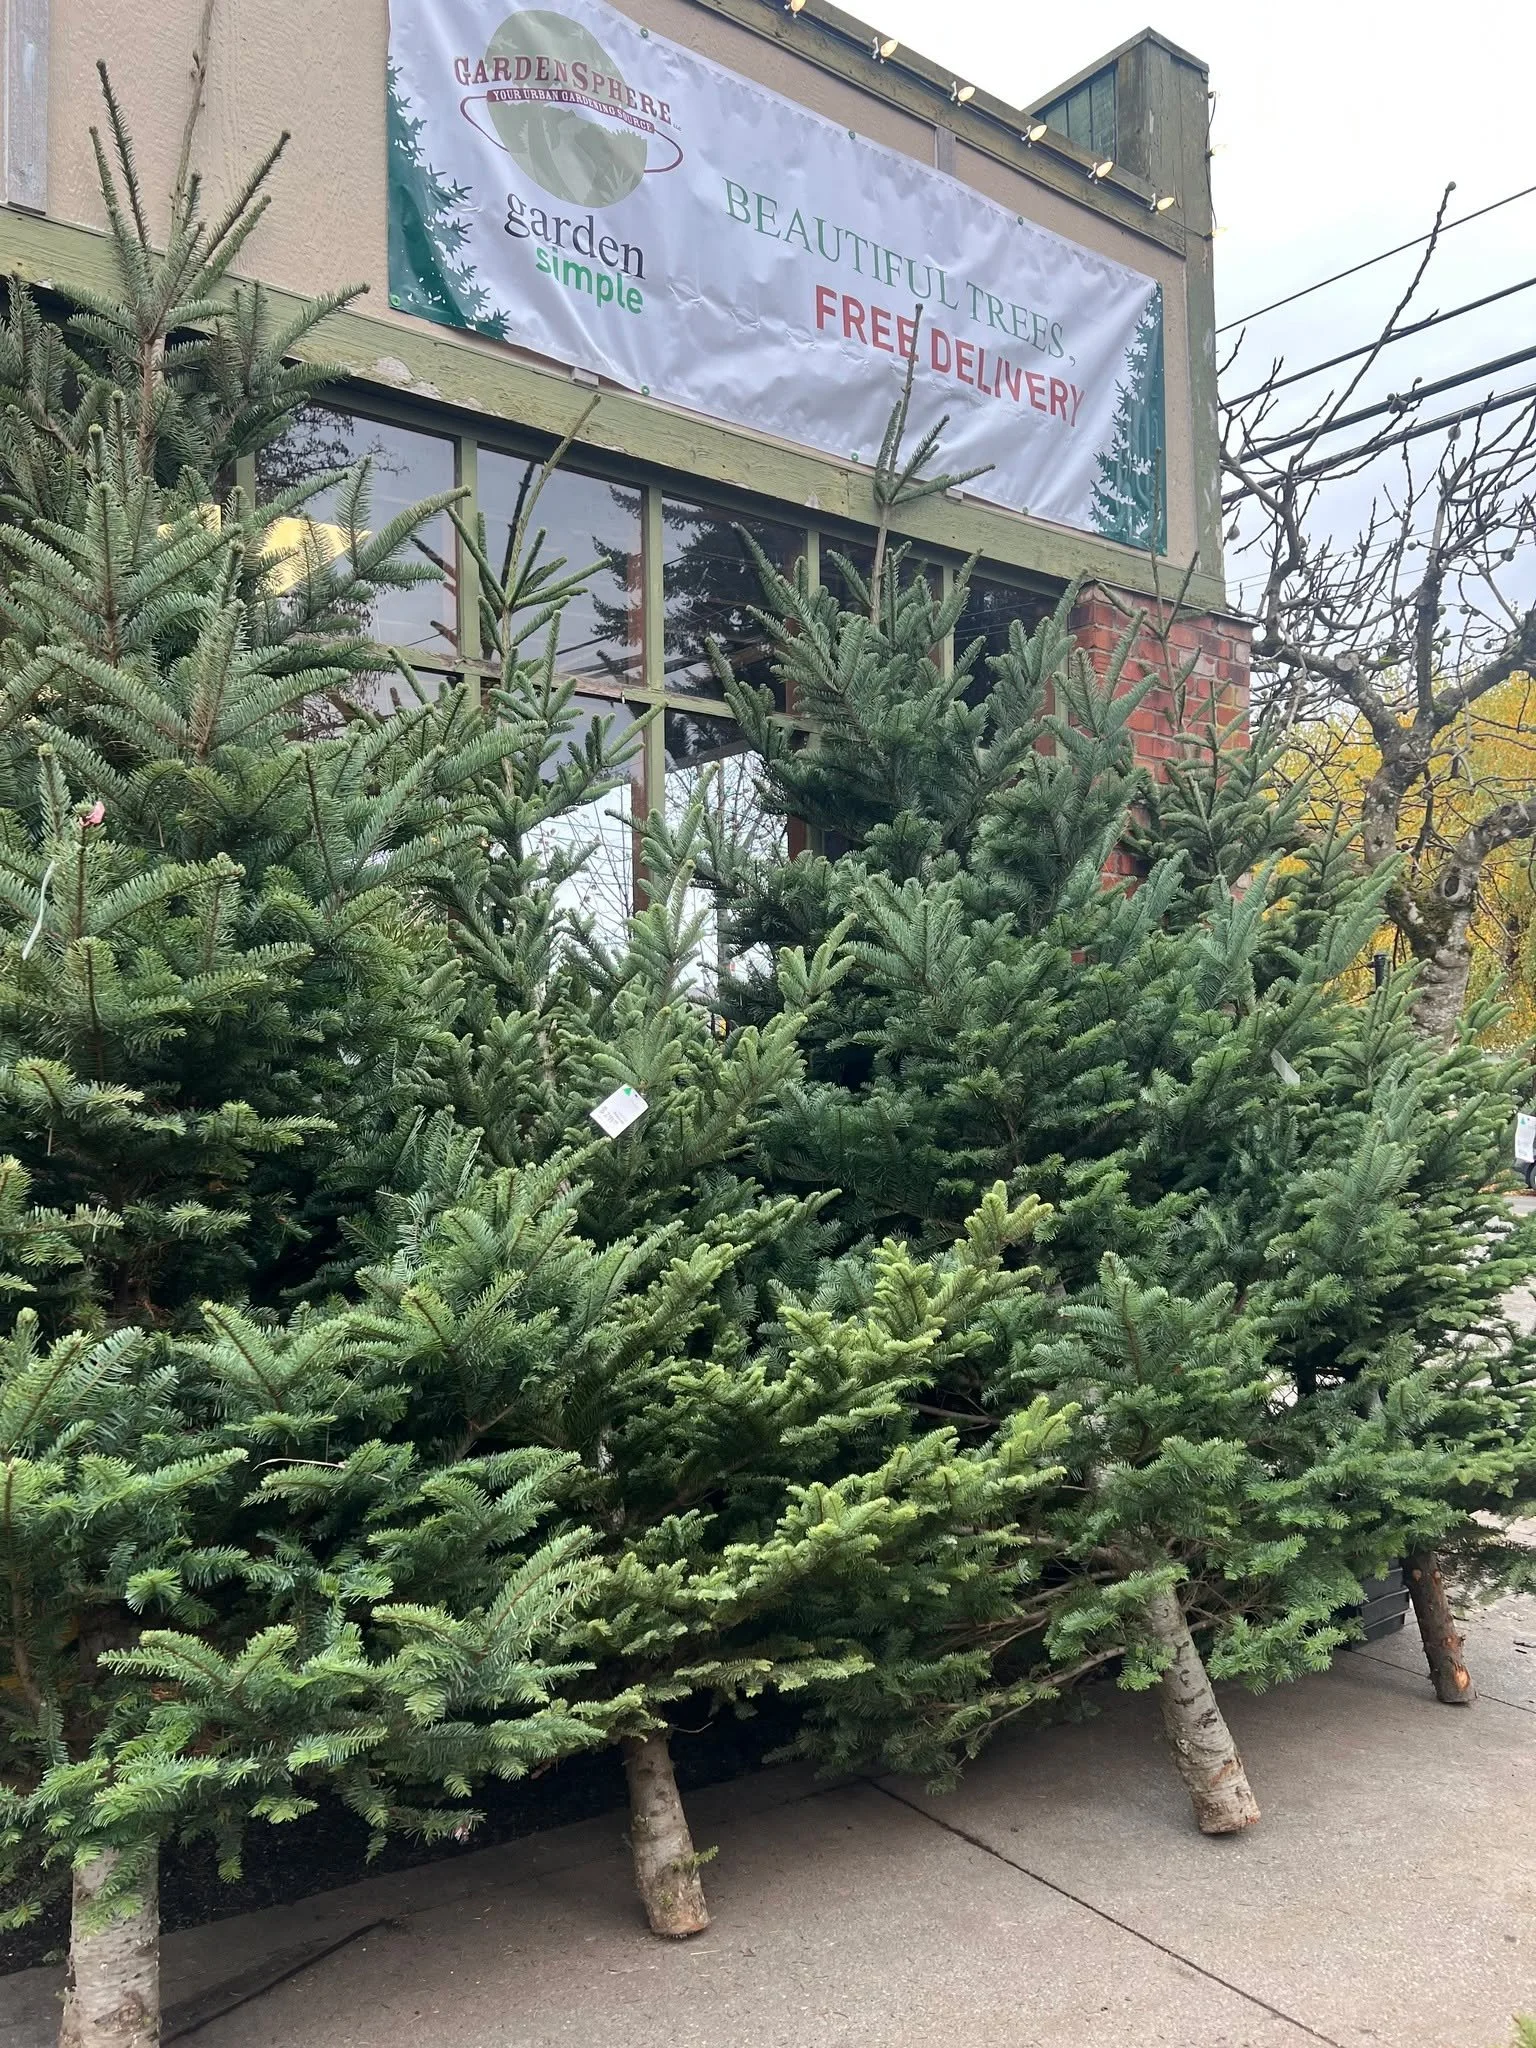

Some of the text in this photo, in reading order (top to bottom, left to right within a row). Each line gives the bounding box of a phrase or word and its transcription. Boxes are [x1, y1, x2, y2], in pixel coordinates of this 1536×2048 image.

[493, 89, 653, 132] YOUR URBAN GARDENING SOURCE
[504, 193, 646, 280] garden
[535, 245, 644, 315] simple
[722, 177, 1077, 367] BEAUTIFUL TREES,
[815, 284, 1086, 428] FREE DELIVERY
